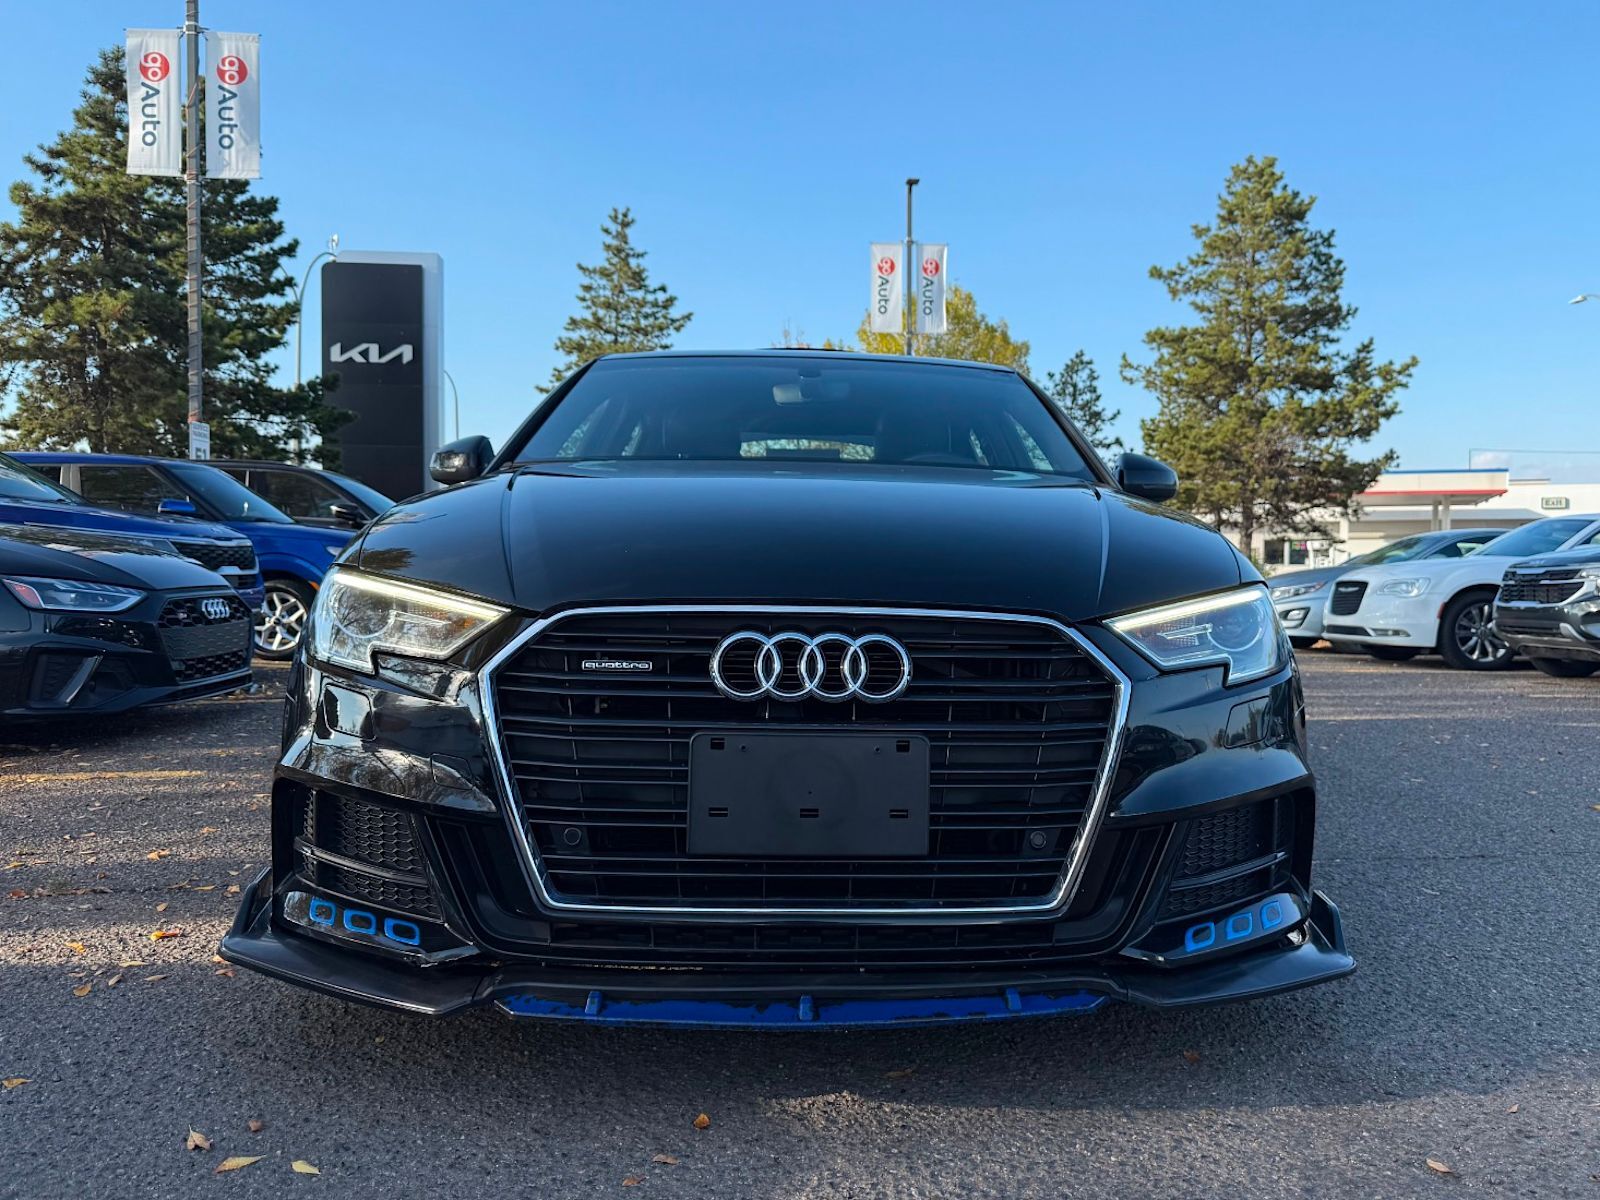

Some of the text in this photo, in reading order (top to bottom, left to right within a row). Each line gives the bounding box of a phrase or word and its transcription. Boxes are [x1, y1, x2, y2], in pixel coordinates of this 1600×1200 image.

[141, 53, 163, 147] go Auto
[218, 57, 240, 149] go Auto
[878, 276, 889, 315] Auto
[923, 277, 934, 316] Auto
[330, 342, 413, 364] KIA
[585, 661, 649, 670] quattro
